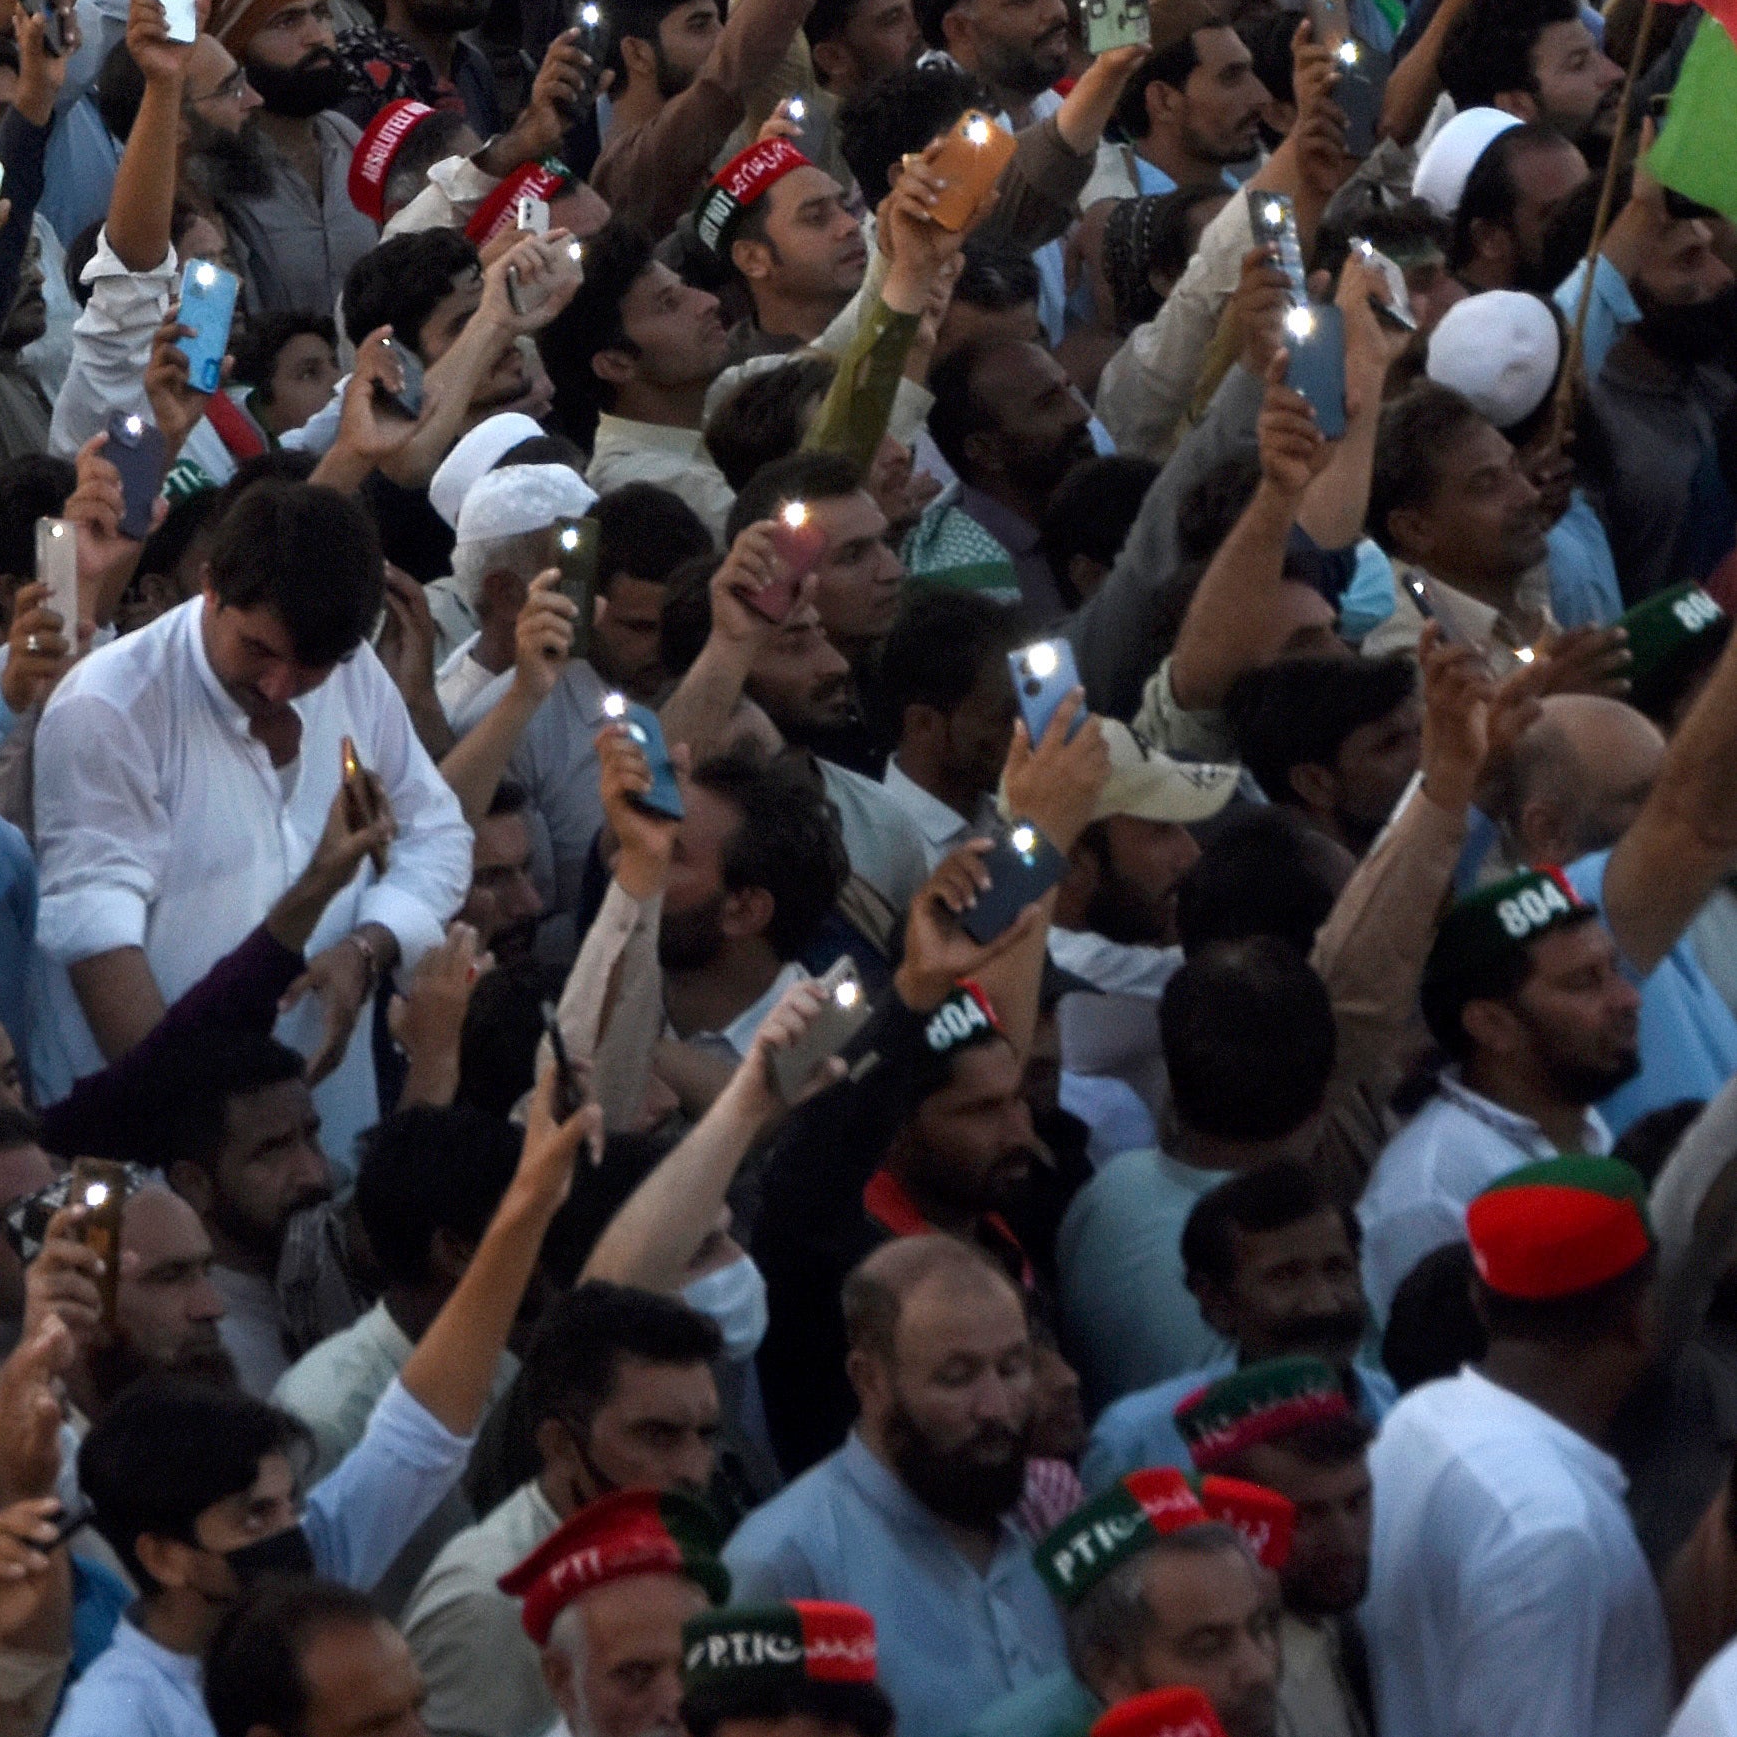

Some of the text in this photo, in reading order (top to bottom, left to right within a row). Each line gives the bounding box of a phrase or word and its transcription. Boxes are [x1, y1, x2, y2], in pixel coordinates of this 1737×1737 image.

[1672, 589, 1724, 632] 804
[1496, 879, 1570, 937] 804
[926, 993, 988, 1049] 804
[1052, 1520, 1115, 1583] PTI
